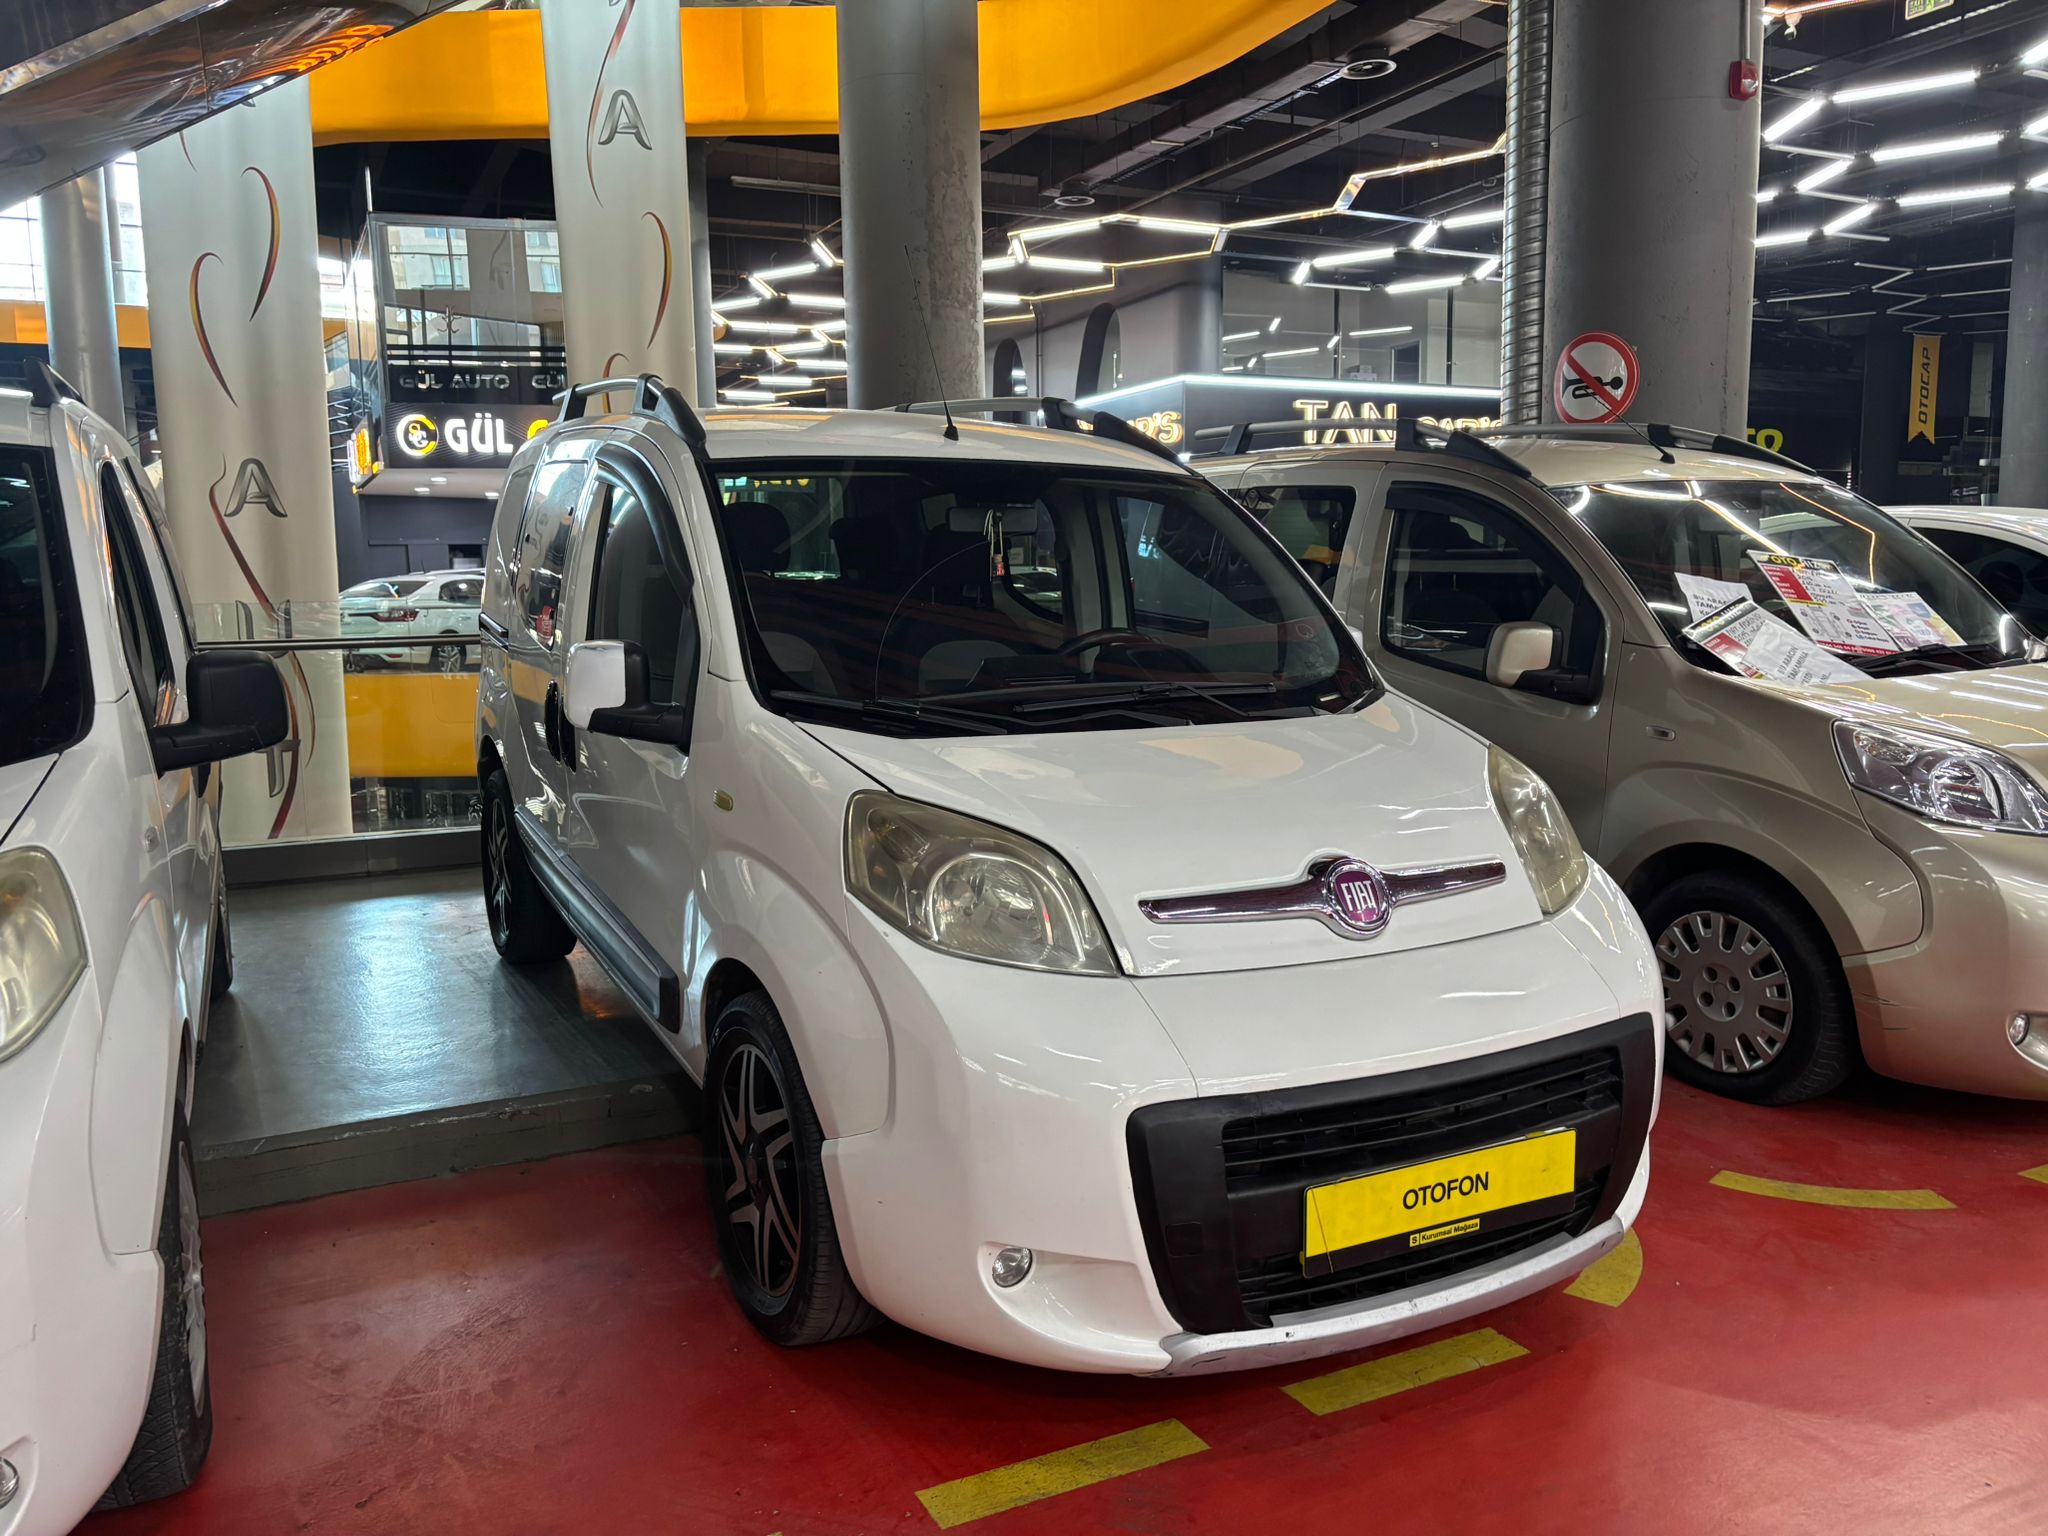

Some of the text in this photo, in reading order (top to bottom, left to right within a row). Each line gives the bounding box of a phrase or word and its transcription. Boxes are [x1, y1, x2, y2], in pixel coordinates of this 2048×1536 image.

[451, 373, 510, 390] AUTO
[1918, 346, 1931, 425] OTOCAP
[443, 412, 514, 454] GÜL
[1293, 399, 1397, 445] TAN
[1341, 881, 1377, 912] FIAT
[1402, 1171, 1489, 1210] OTOFON
[1421, 1227, 1453, 1241] Kurumsal
[1453, 1221, 1479, 1233] Mağaza
